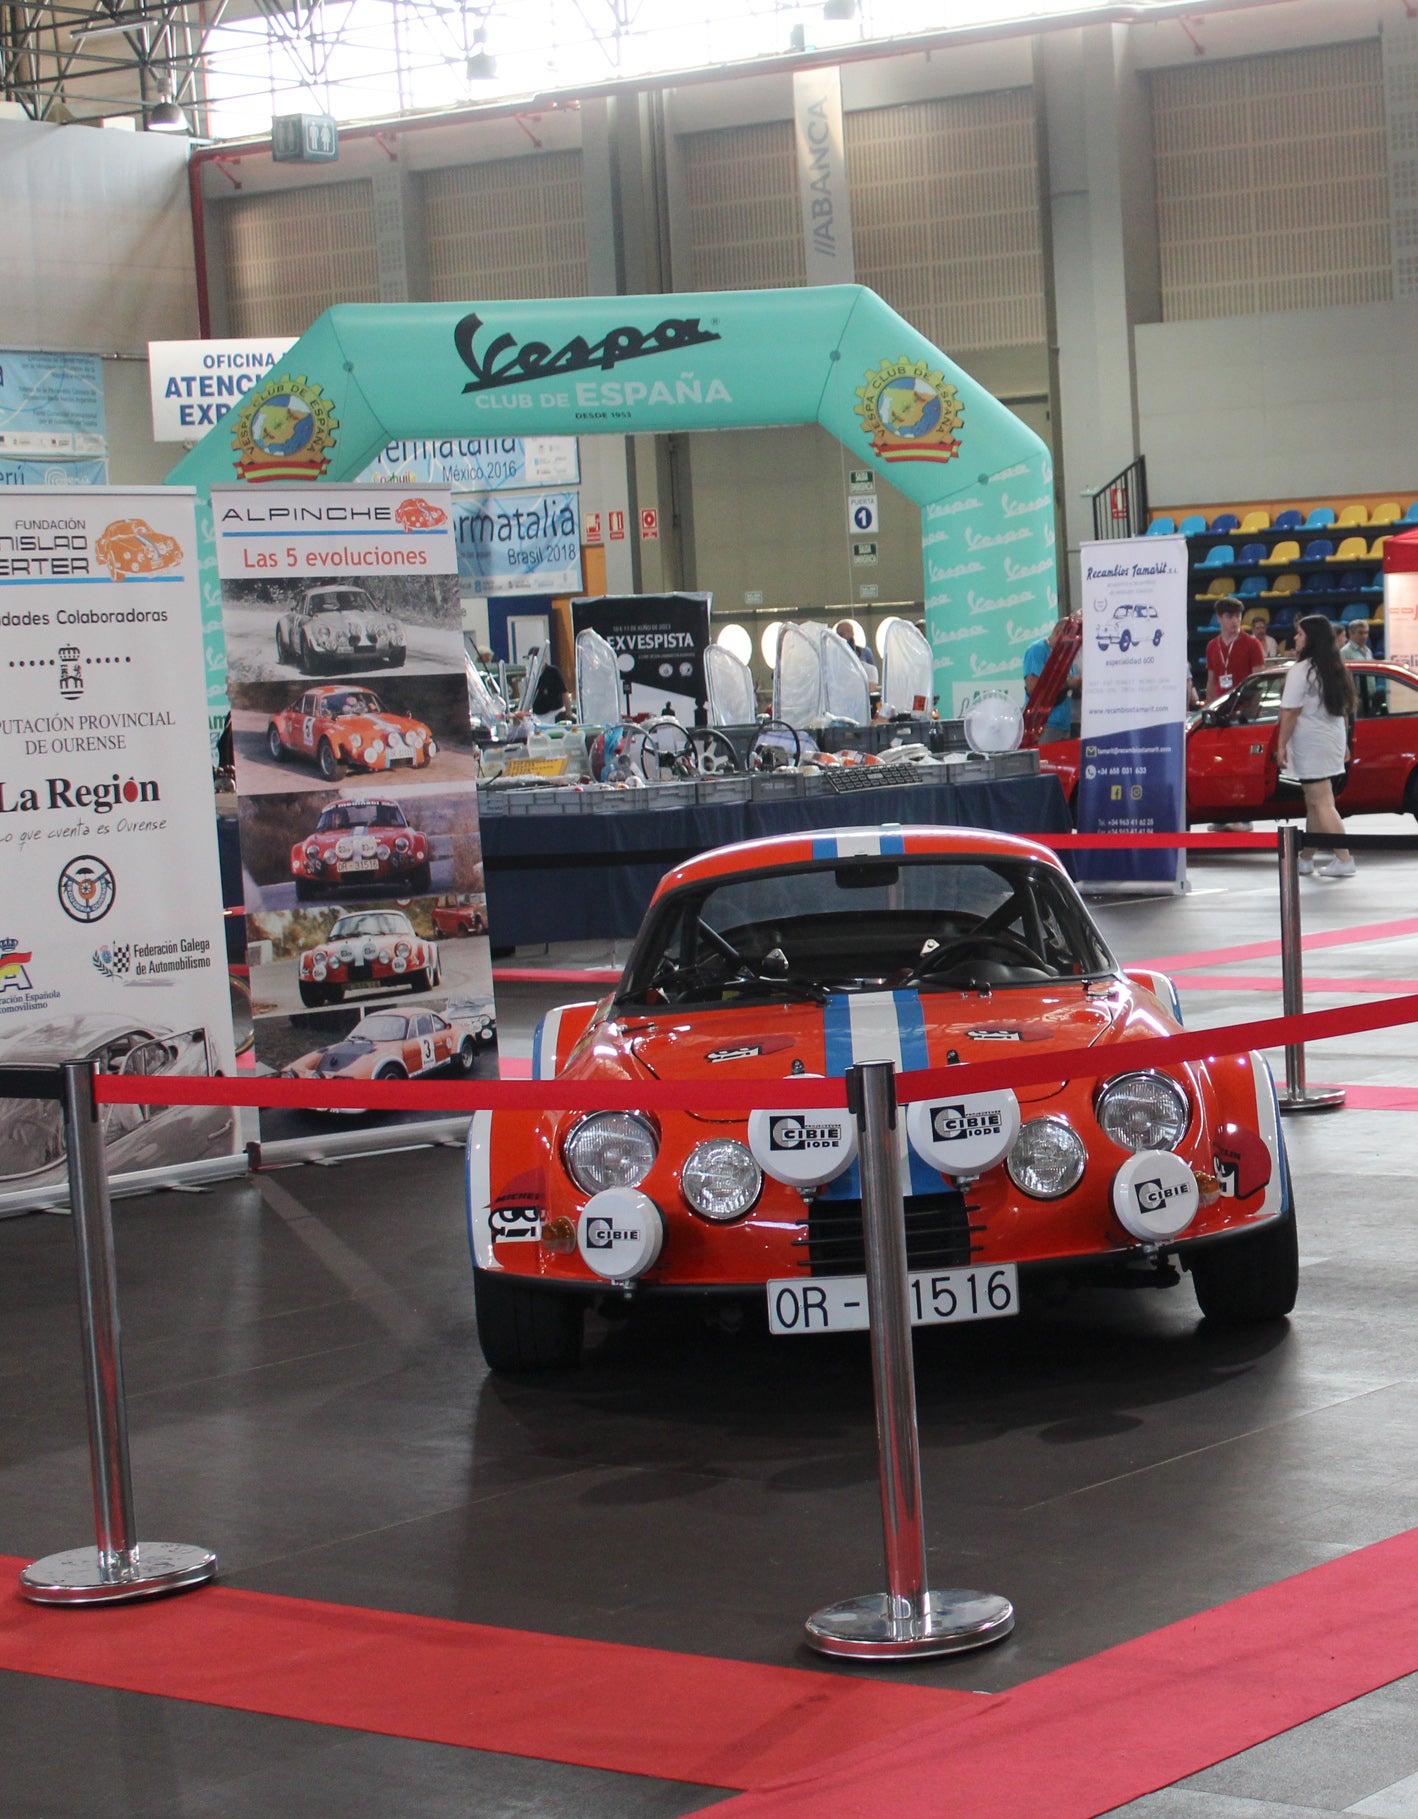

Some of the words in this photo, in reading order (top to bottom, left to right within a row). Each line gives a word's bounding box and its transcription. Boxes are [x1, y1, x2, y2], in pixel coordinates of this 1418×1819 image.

[203, 353, 276, 369] OFICINA
[454, 312, 722, 395] Vespa
[474, 393, 534, 409] CLUB
[540, 393, 570, 408] DE
[575, 371, 733, 407] ESPAÑA
[575, 412, 607, 420] DESDE
[442, 464, 484, 482] México
[487, 460, 517, 479] 2016
[15, 517, 86, 530] FUNDACIÓN
[222, 506, 391, 522] ALPINCHE
[453, 499, 576, 545] rmatalia
[243, 548, 278, 569] Las
[286, 547, 298, 567] 5
[305, 546, 428, 567] evoluciones
[507, 546, 543, 565] Brasil
[546, 543, 576, 562] 2018
[1086, 565, 1129, 580] Recambios
[1132, 562, 1168, 577] Tamarit
[56, 607, 168, 625] Colaboradoras
[0, 713, 75, 736] UTACIÓN
[79, 711, 176, 731] PROVINCIAL
[25, 739, 47, 755] DE
[51, 735, 127, 754] OURENSE
[0, 781, 41, 813] La
[45, 773, 161, 815] Región
[19, 828, 42, 852] que
[48, 818, 91, 839] cuenta
[97, 824, 111, 835] es
[117, 818, 168, 833] Ourense
[134, 942, 178, 958] Federación
[180, 937, 210, 954] Galega
[136, 962, 147, 975] de
[148, 956, 211, 974] Automobilismo
[0, 994, 24, 1004] ación
[25, 989, 61, 1002] Española
[0, 1001, 48, 1014] omovilismo
[968, 1127, 1001, 1137] IODE
[806, 1140, 840, 1148] IODE
